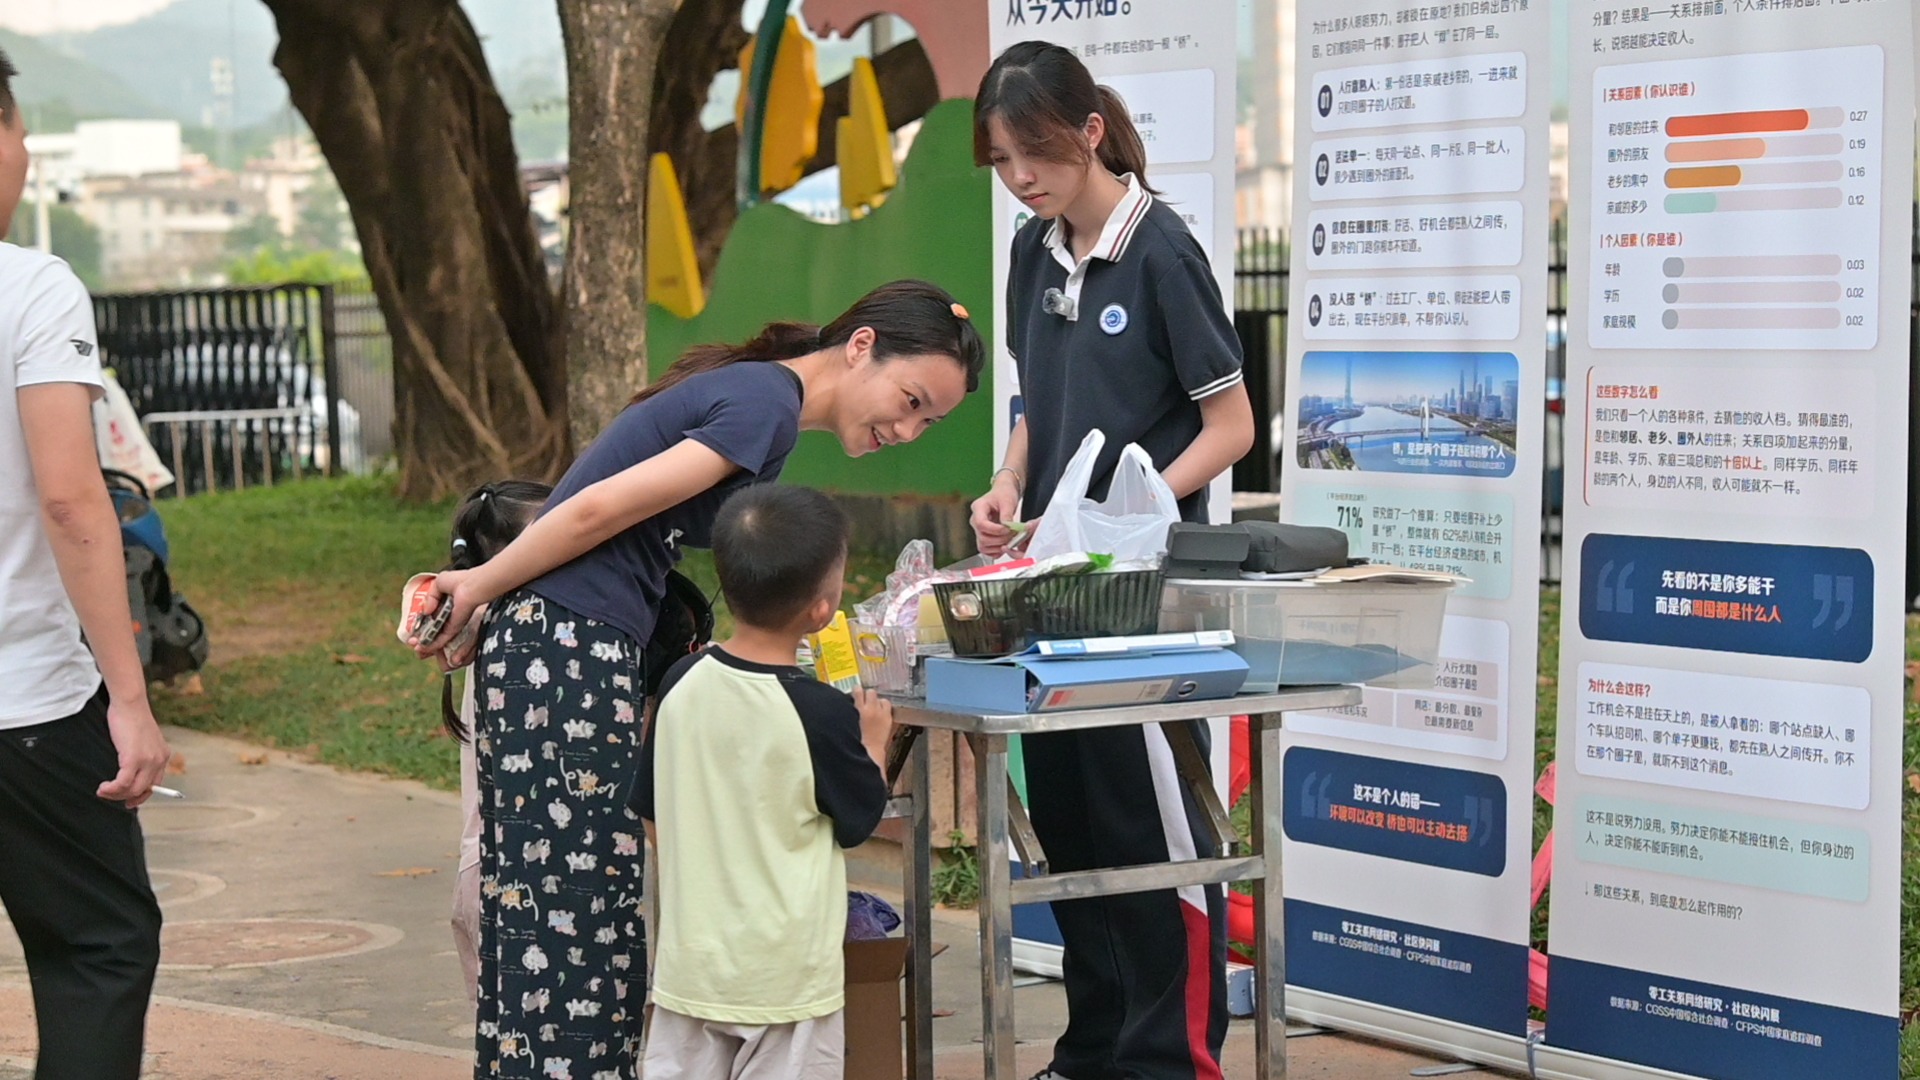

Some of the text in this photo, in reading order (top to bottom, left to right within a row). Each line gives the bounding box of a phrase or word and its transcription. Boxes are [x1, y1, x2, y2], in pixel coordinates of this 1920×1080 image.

[1608, 110, 1868, 137] 和邻居的往来 0.27
[1607, 138, 1866, 163] 圈外的朋友 0.19
[1606, 166, 1866, 189] 老乡的集中 0.16
[1606, 194, 1865, 215] 亲戚的多少 0.12
[1604, 258, 1865, 277] 年龄 0.03
[1603, 286, 1864, 303] 学历 0.02
[1602, 314, 1864, 329] 家庭规模 0.02
[1596, 384, 1658, 399] 这些数字怎么看
[1337, 505, 1364, 529] 71%
[1661, 569, 1776, 596] 先看的不是你多能干
[1655, 595, 1782, 624] 而是你周围都是什么人
[1329, 804, 1386, 830] 环境可以改变
